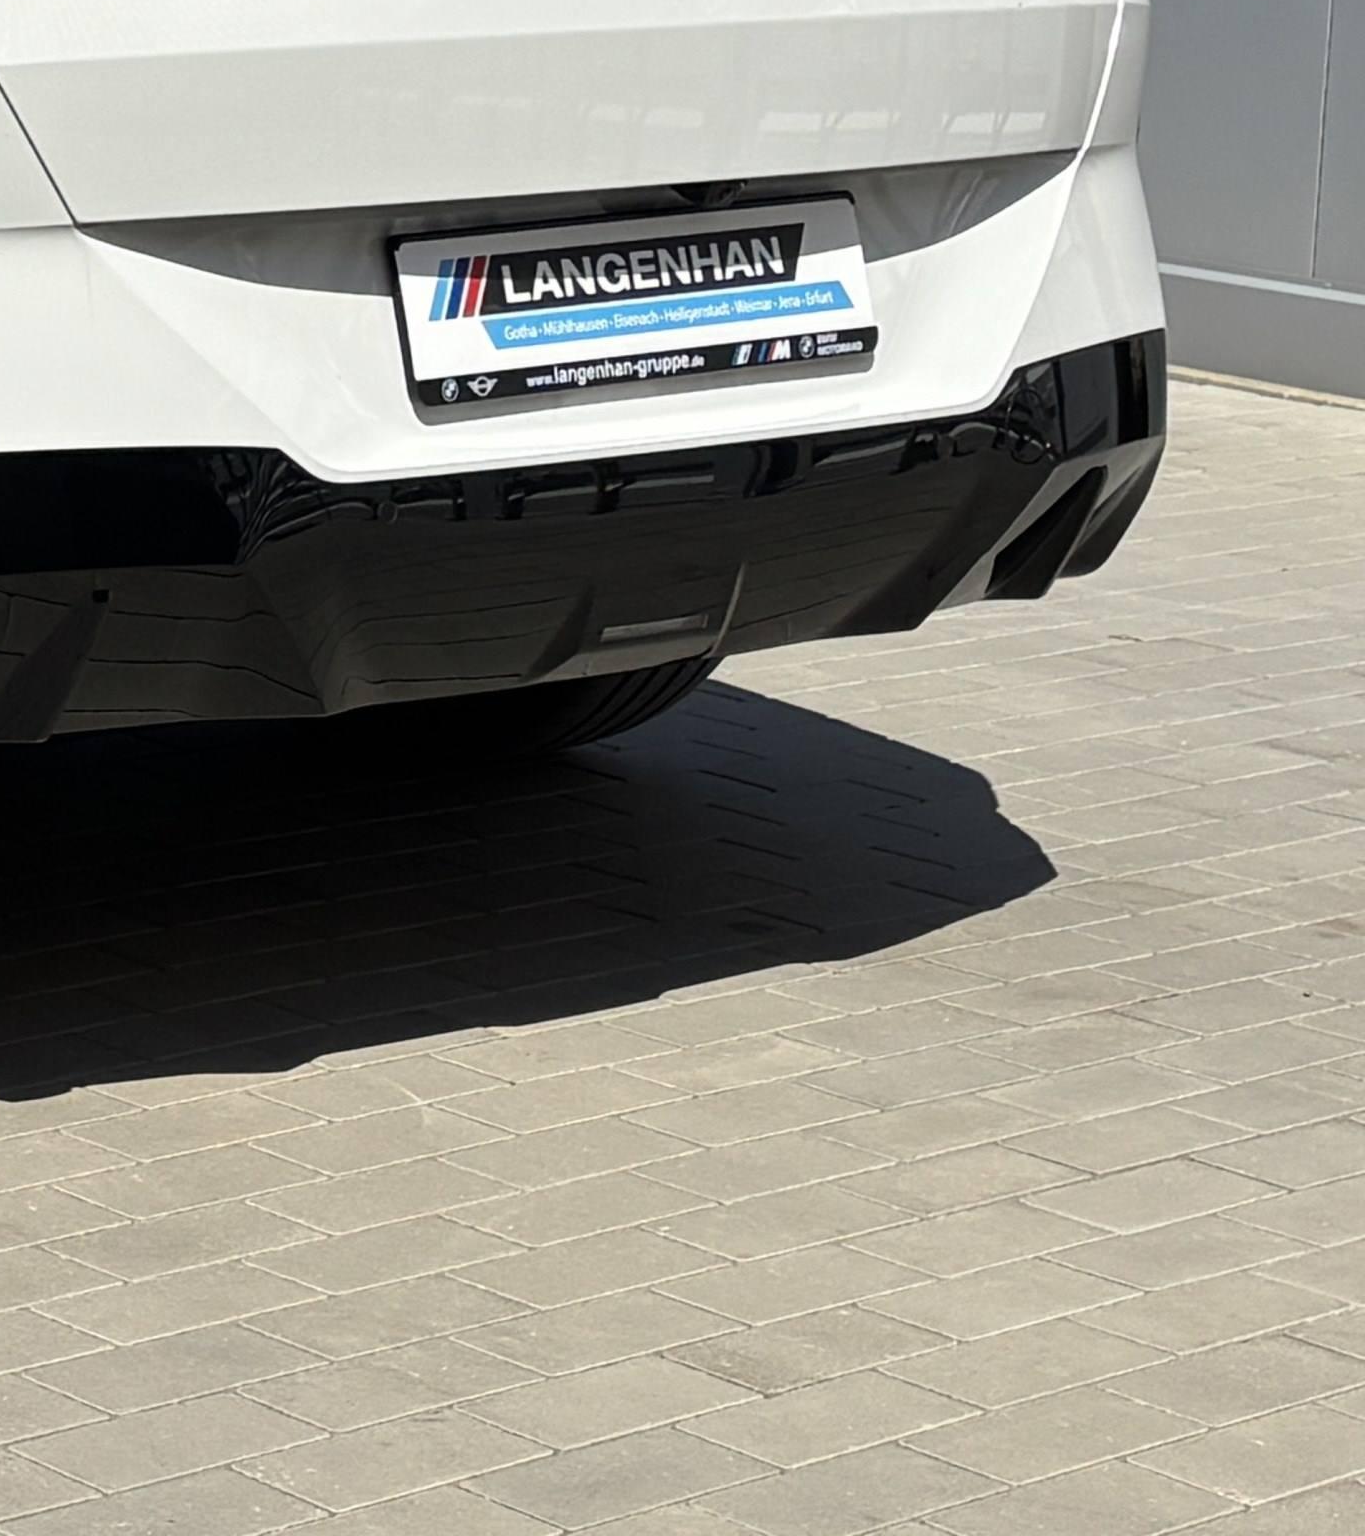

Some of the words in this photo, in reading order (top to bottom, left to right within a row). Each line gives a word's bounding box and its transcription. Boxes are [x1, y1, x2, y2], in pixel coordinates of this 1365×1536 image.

[500, 235, 786, 305] LANGENHAN
[503, 323, 538, 341] Gotha
[543, 316, 609, 337] Mühlhausen
[613, 310, 660, 328] Eisenach
[805, 290, 835, 307] Erfurt
[525, 354, 707, 388] www.langenhan-gruppe.de
